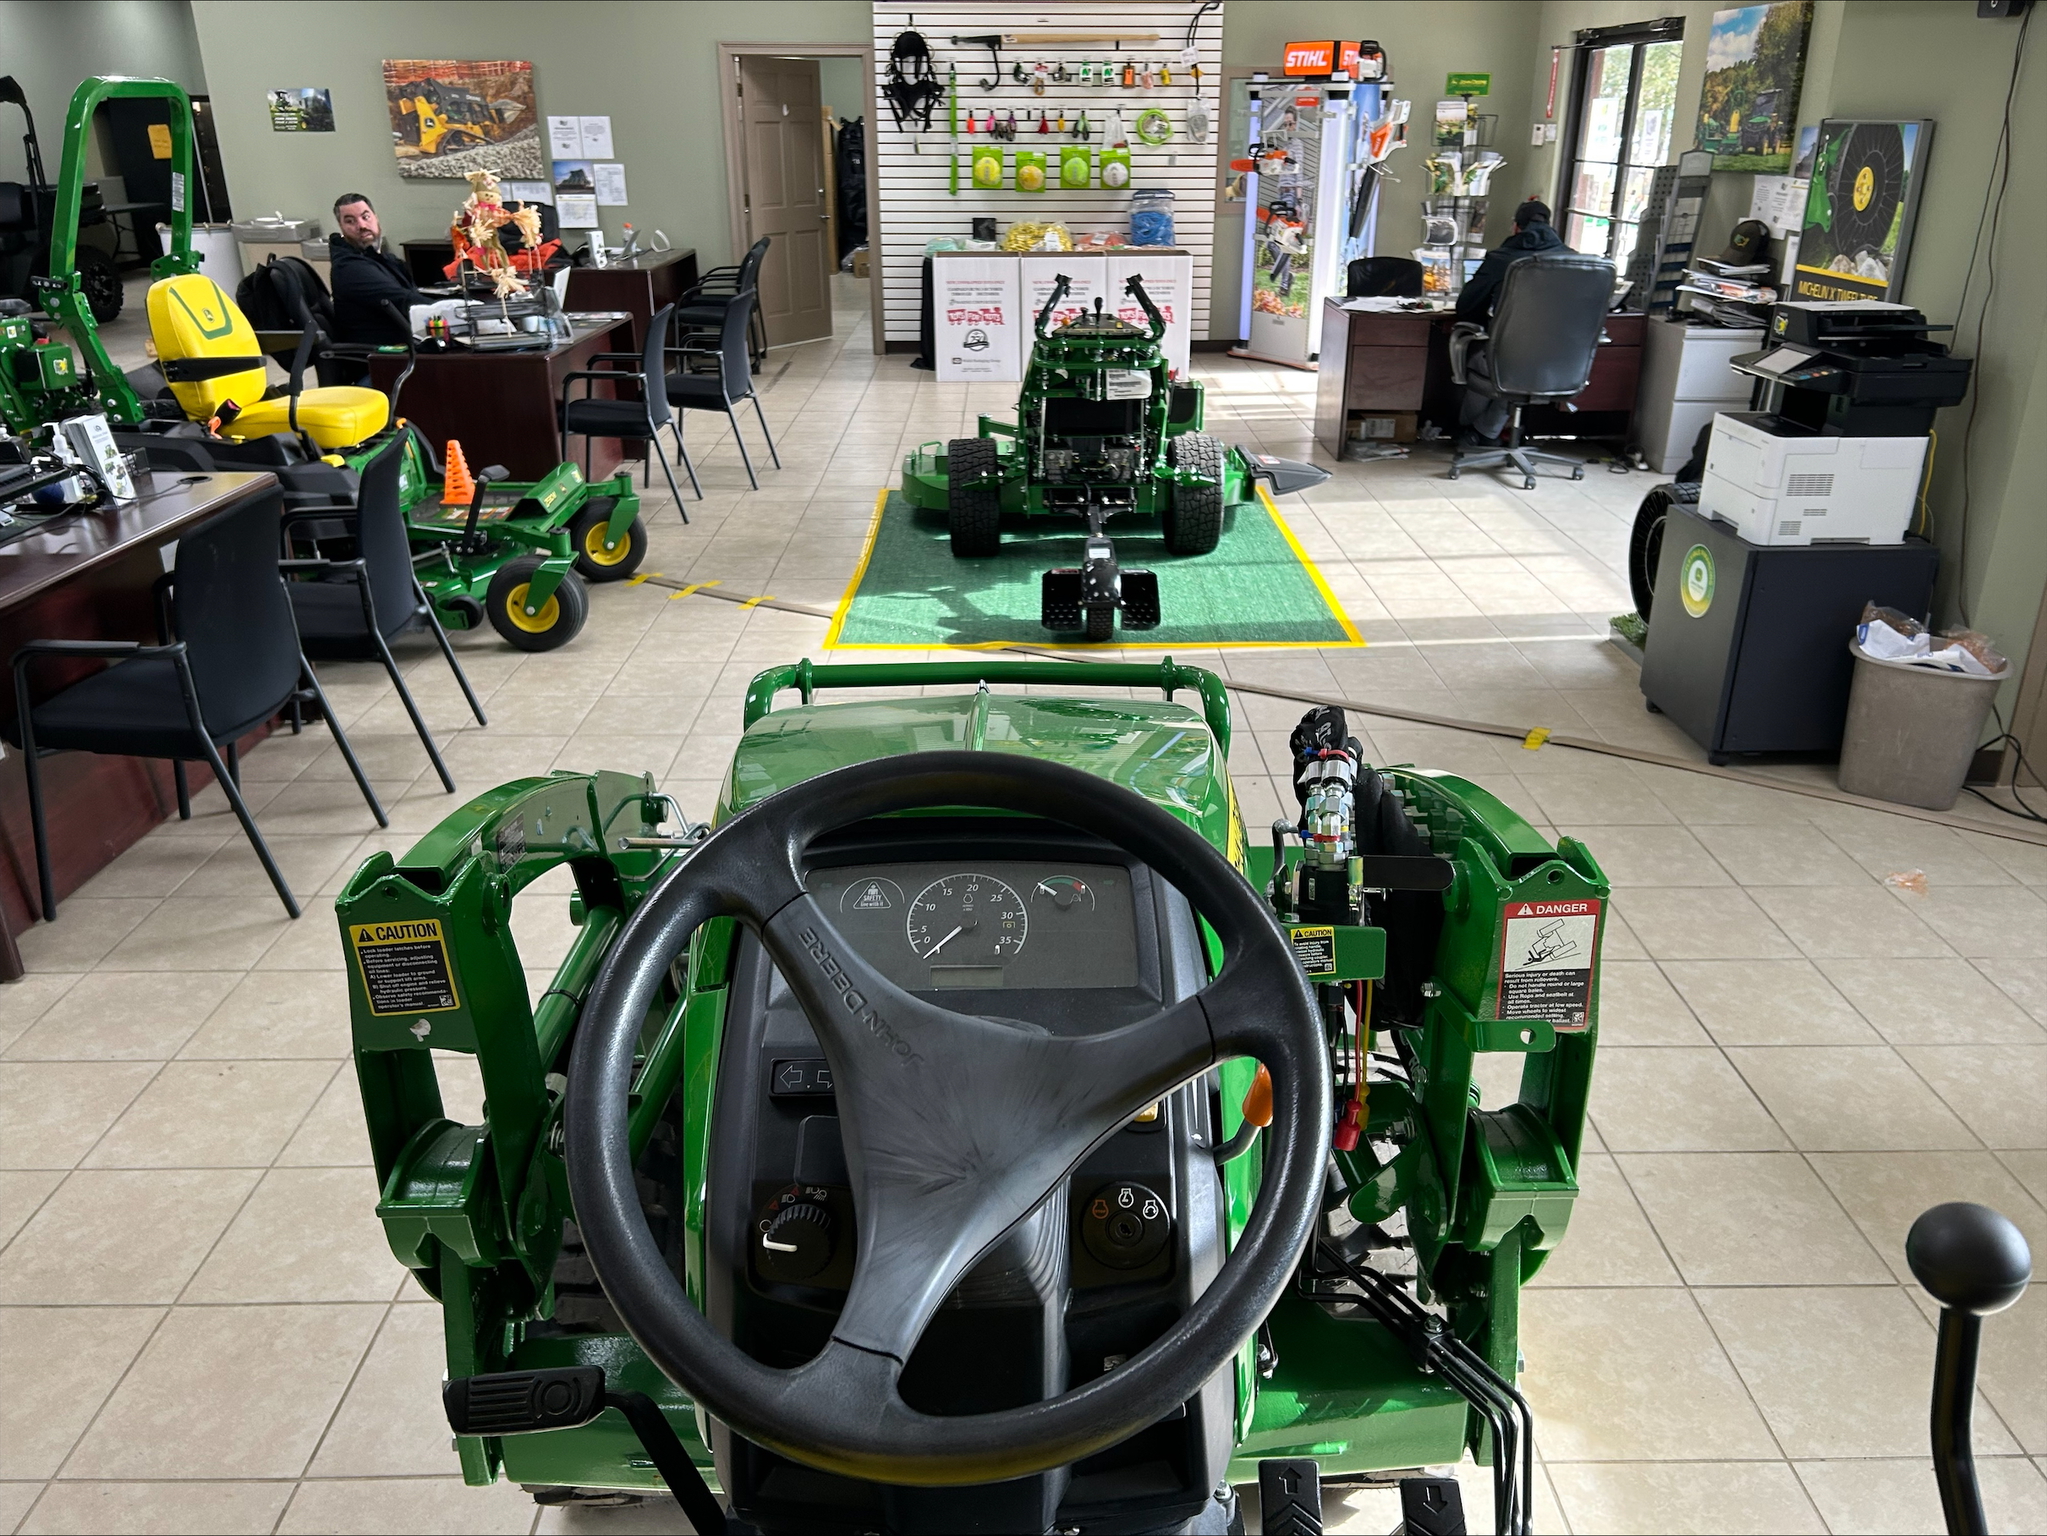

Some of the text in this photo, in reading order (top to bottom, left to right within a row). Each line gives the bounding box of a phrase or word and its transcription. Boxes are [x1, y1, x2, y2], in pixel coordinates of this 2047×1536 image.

[1286, 50, 1328, 67] STIHL
[1798, 280, 1830, 300] MICHELIN
[1829, 288, 1836, 300] X
[1536, 903, 1587, 914] DANGER
[376, 923, 438, 940] CAUTION
[798, 926, 924, 1067] JOHN DEERE
